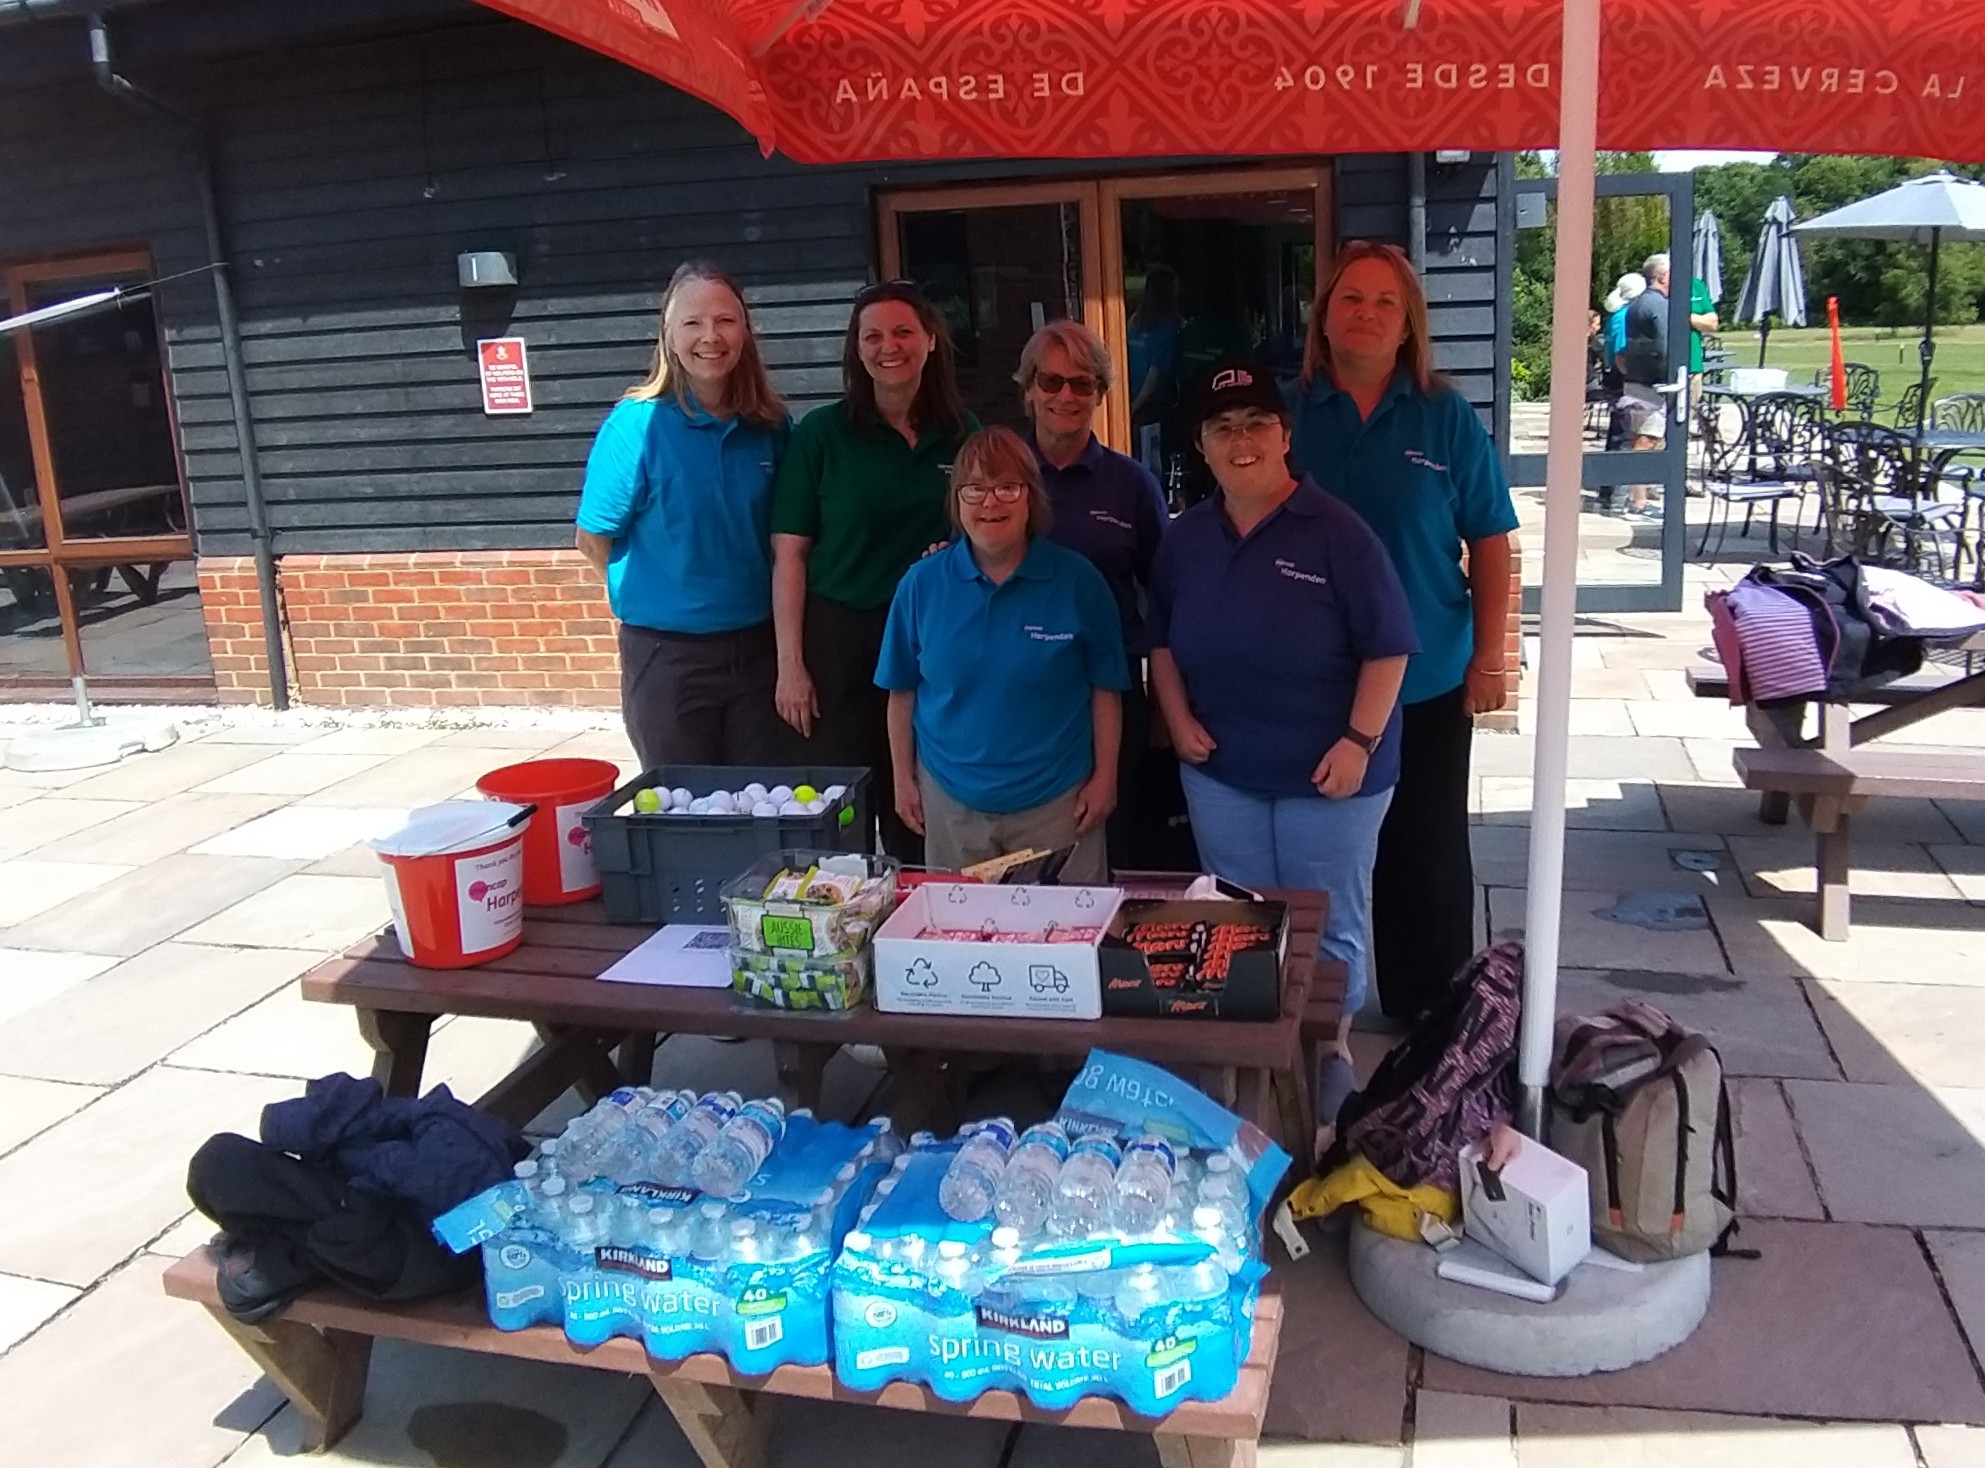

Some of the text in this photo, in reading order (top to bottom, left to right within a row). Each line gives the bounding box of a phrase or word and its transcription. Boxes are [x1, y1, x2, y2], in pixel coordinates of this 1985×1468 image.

[771, 920, 803, 934] AUSSIE
[600, 1248, 669, 1274] KIRKLAND
[641, 1284, 721, 1317] water
[743, 1287, 767, 1302] 40
[980, 1307, 1066, 1334] KIRKLAND
[929, 1333, 1122, 1371] spring water
